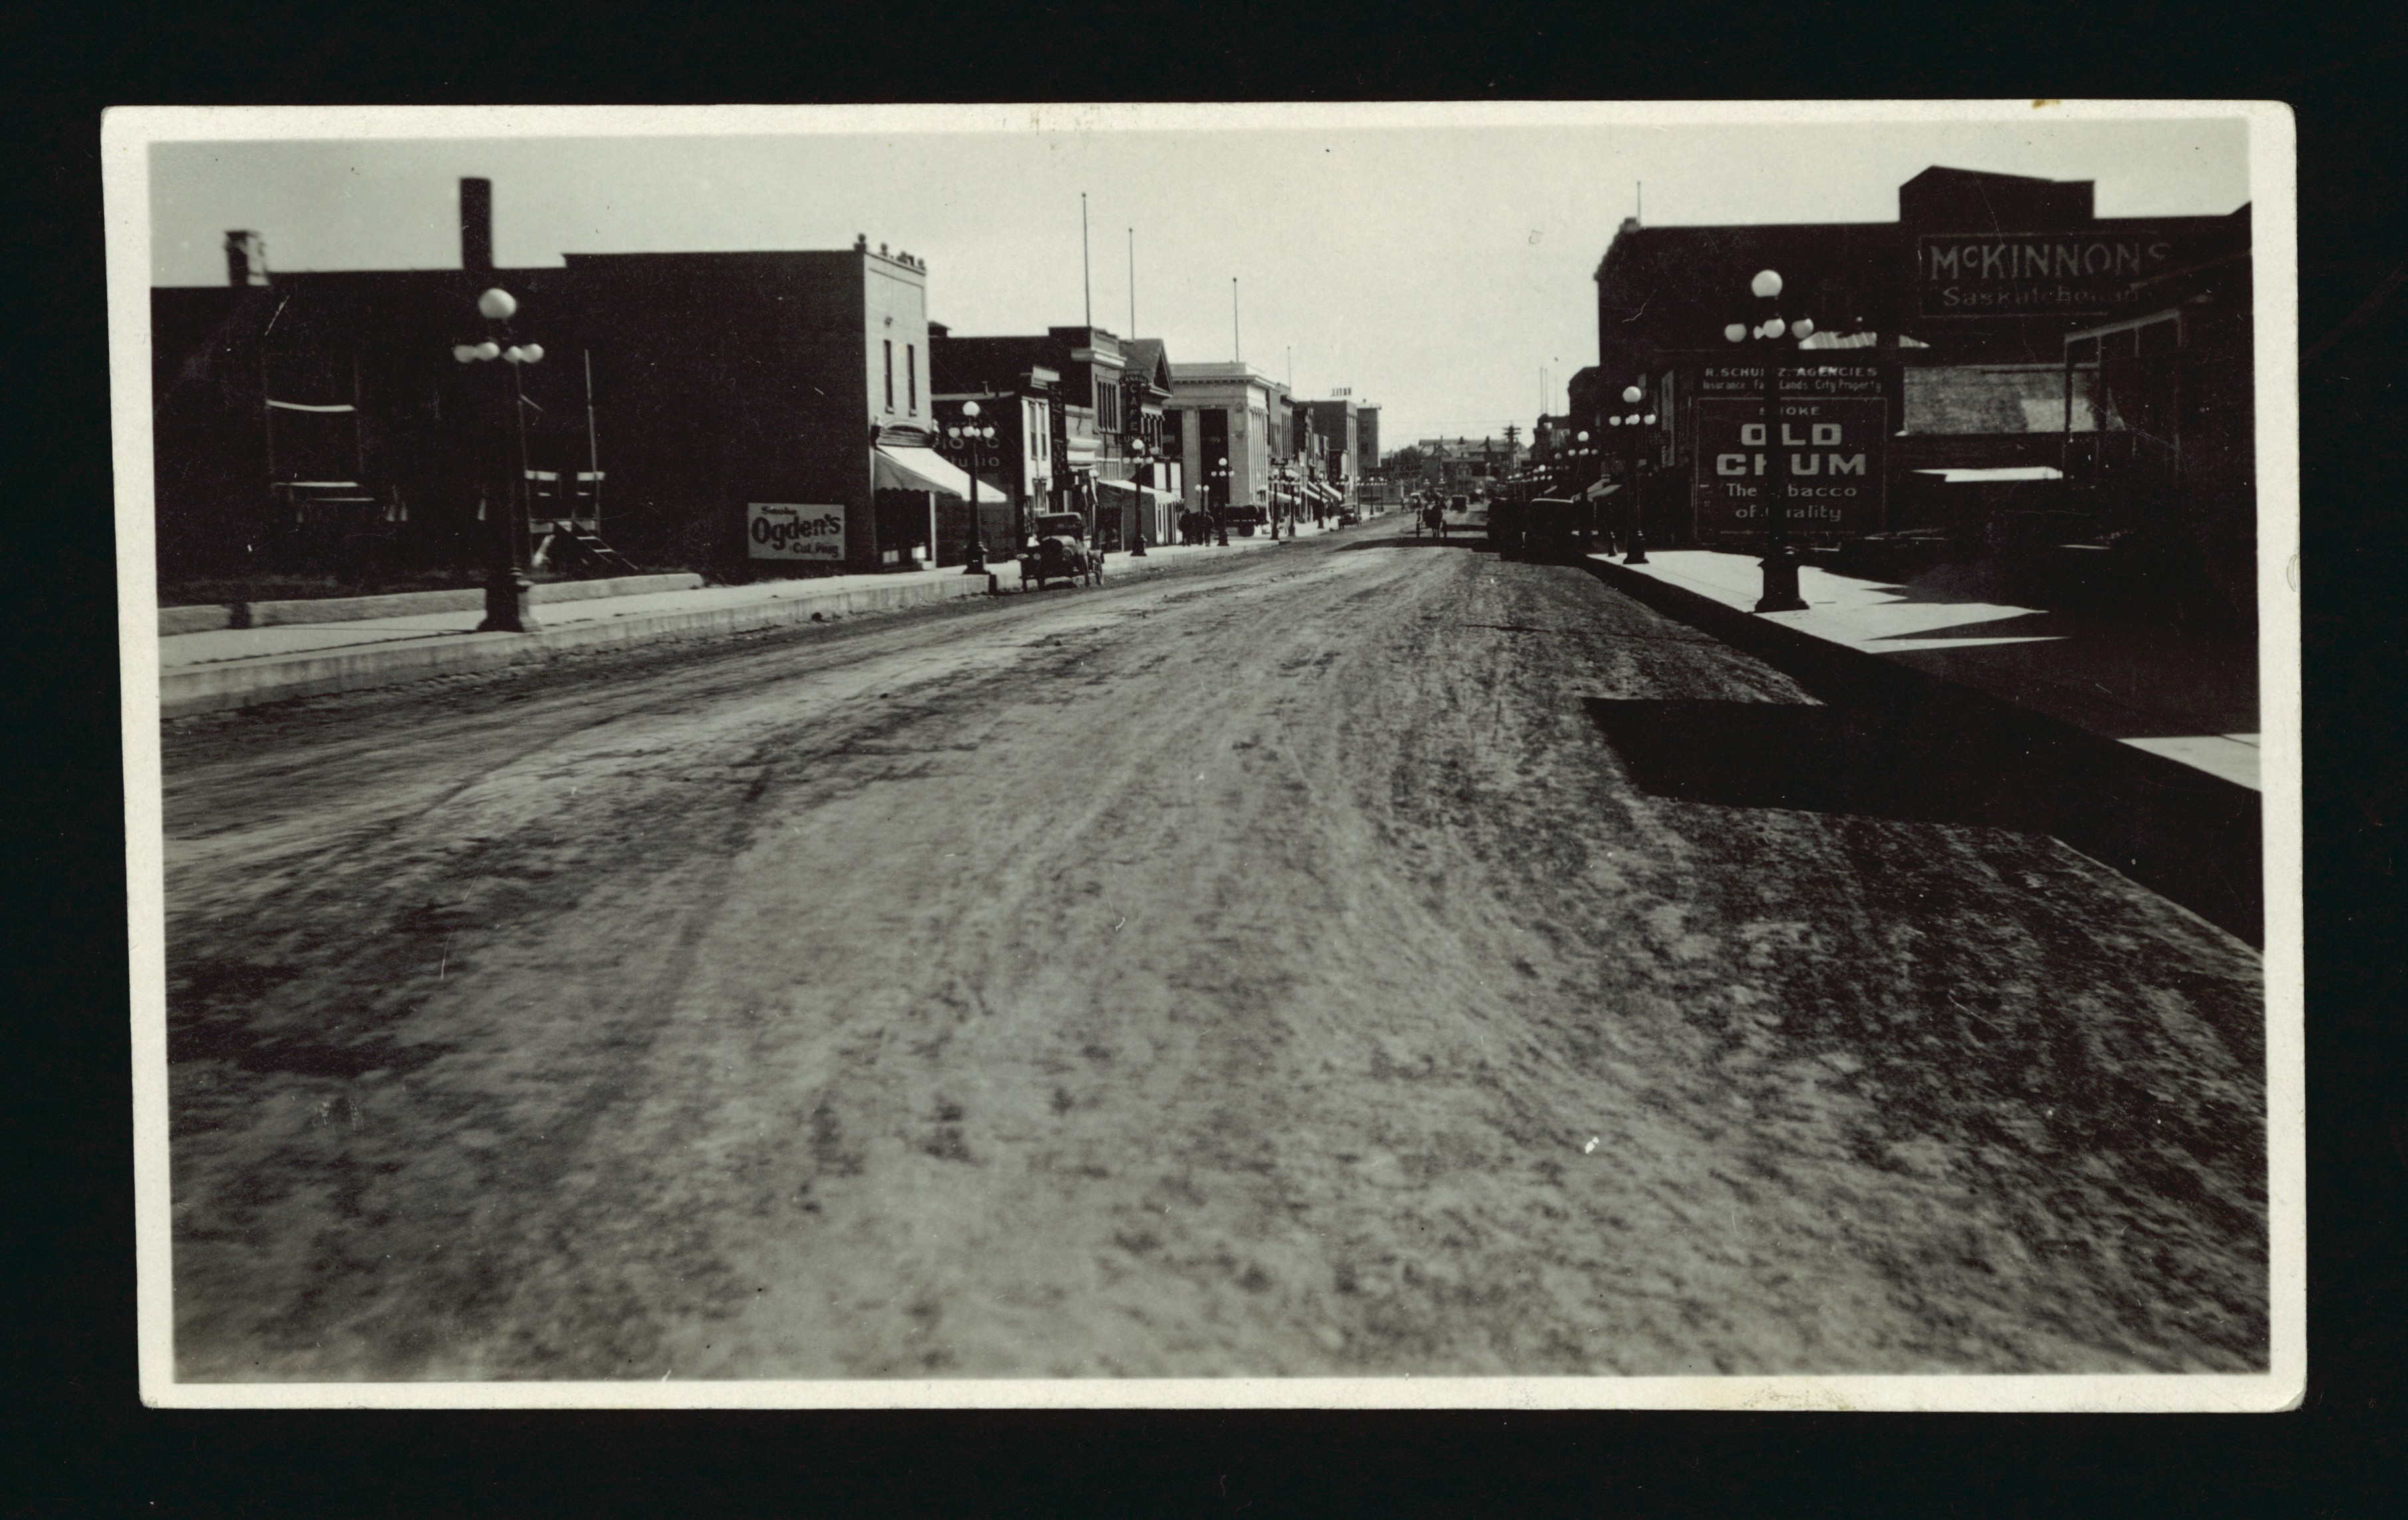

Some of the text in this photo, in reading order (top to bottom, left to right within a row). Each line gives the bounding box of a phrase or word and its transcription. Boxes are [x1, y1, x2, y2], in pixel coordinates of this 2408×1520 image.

[1796, 367, 1878, 377] AGENCIES
[1130, 385, 1138, 431] CAFE
[1759, 406, 1820, 416] SOKE
[1741, 423, 1842, 446] OLD
[1726, 483, 1857, 497] The bacco
[1735, 505, 1757, 518] of
[751, 513, 842, 550] Ogden's
